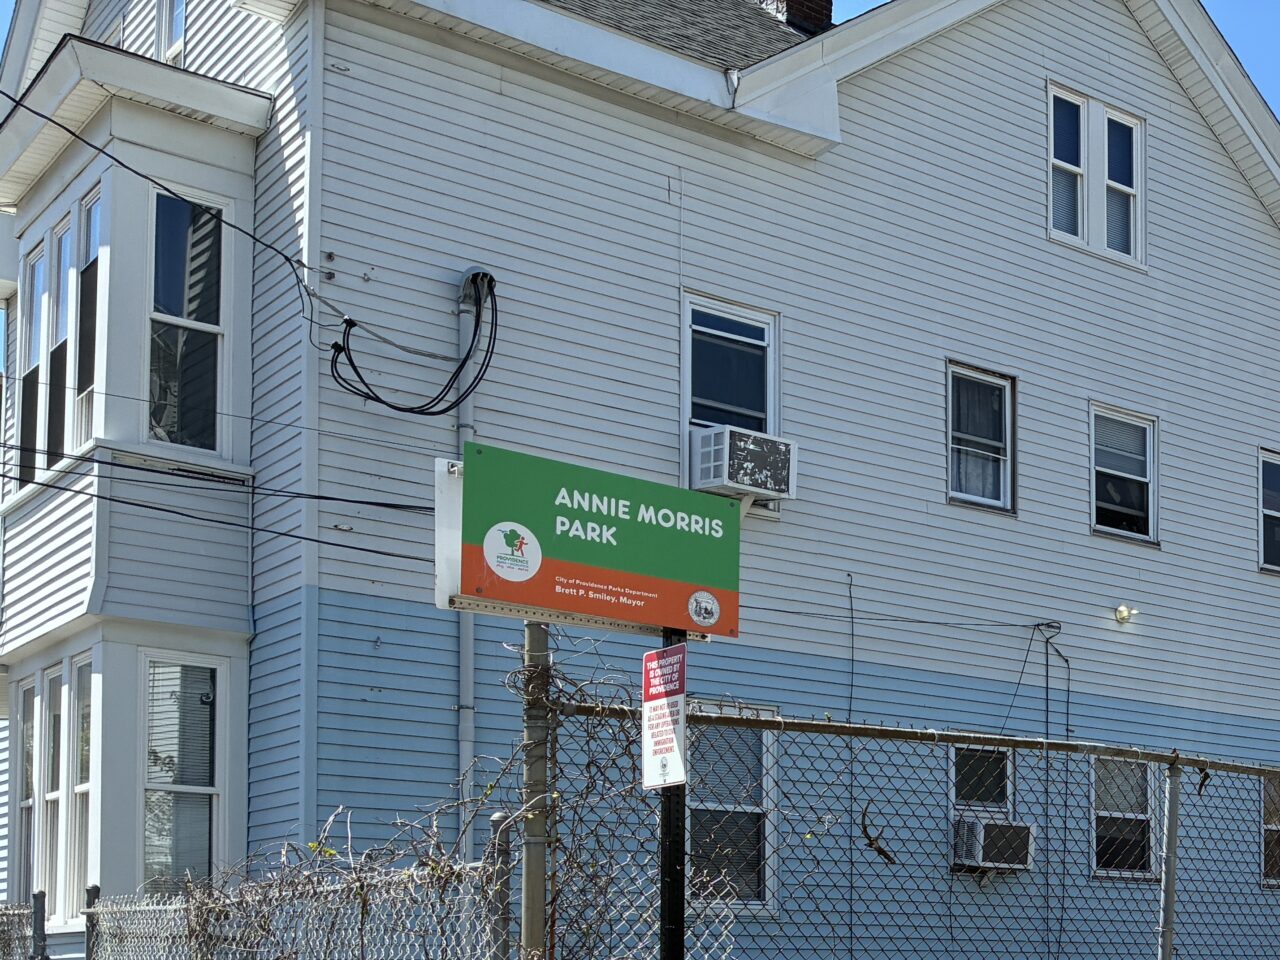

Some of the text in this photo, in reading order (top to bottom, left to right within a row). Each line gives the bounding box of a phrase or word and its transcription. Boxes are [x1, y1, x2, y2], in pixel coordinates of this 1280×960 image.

[555, 487, 724, 539] ANNIE MORRIS
[555, 515, 617, 546] PARK
[555, 576, 568, 584] City
[575, 579, 608, 590] Providence
[608, 585, 624, 593] Parks
[625, 588, 658, 599] Department
[555, 585, 577, 596] Brett
[619, 596, 645, 607] Mayor
[647, 654, 683, 670] THIS PROPERTY
[649, 663, 680, 678] IS OWNED BY
[649, 681, 680, 695] PROVIDENCE
[650, 672, 679, 686] THE CITY OF
